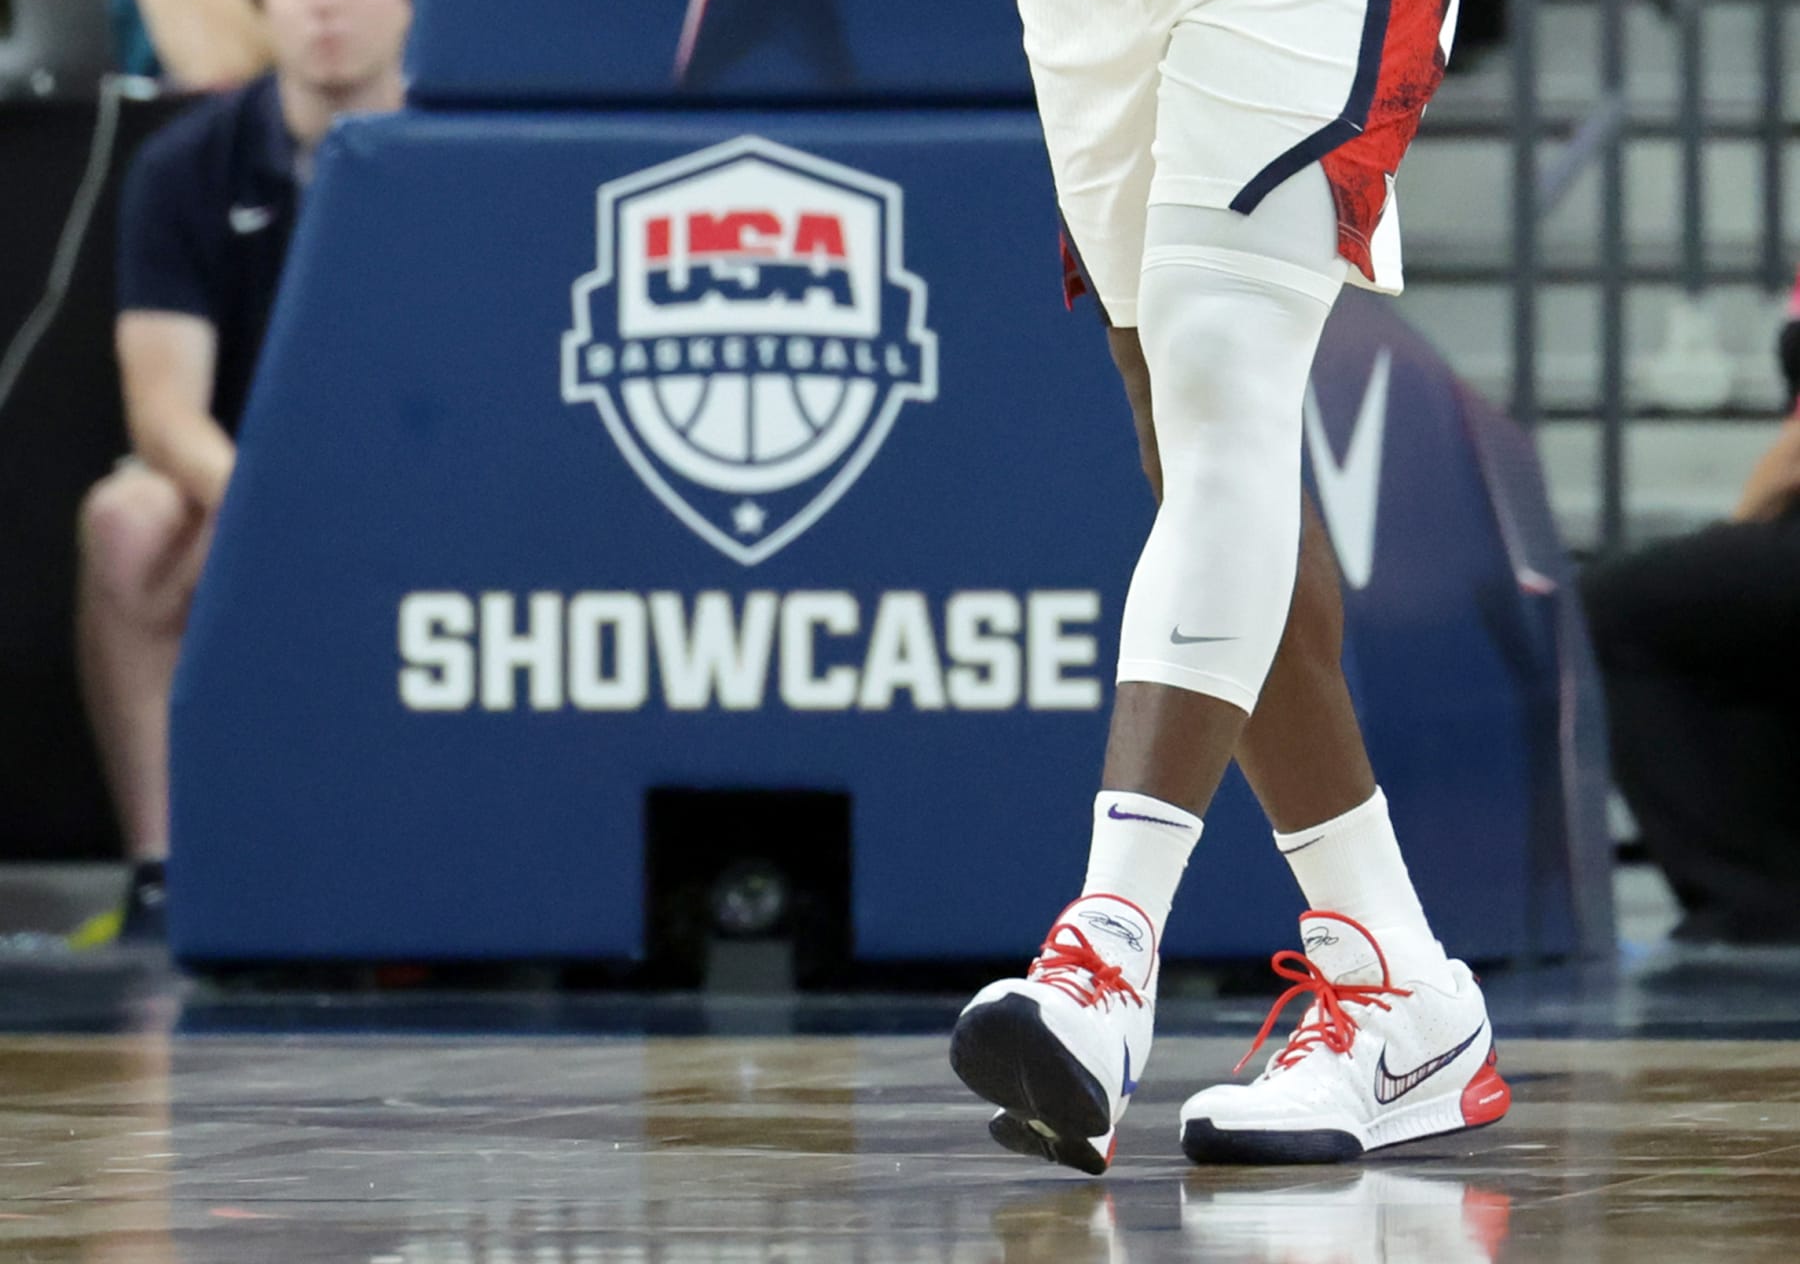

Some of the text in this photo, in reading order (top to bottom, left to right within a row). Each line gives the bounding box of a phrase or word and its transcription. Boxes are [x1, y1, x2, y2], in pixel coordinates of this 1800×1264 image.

[645, 210, 857, 310] USA
[586, 336, 907, 377] BASKETBALL
[398, 590, 1102, 711] SHOWCASE
